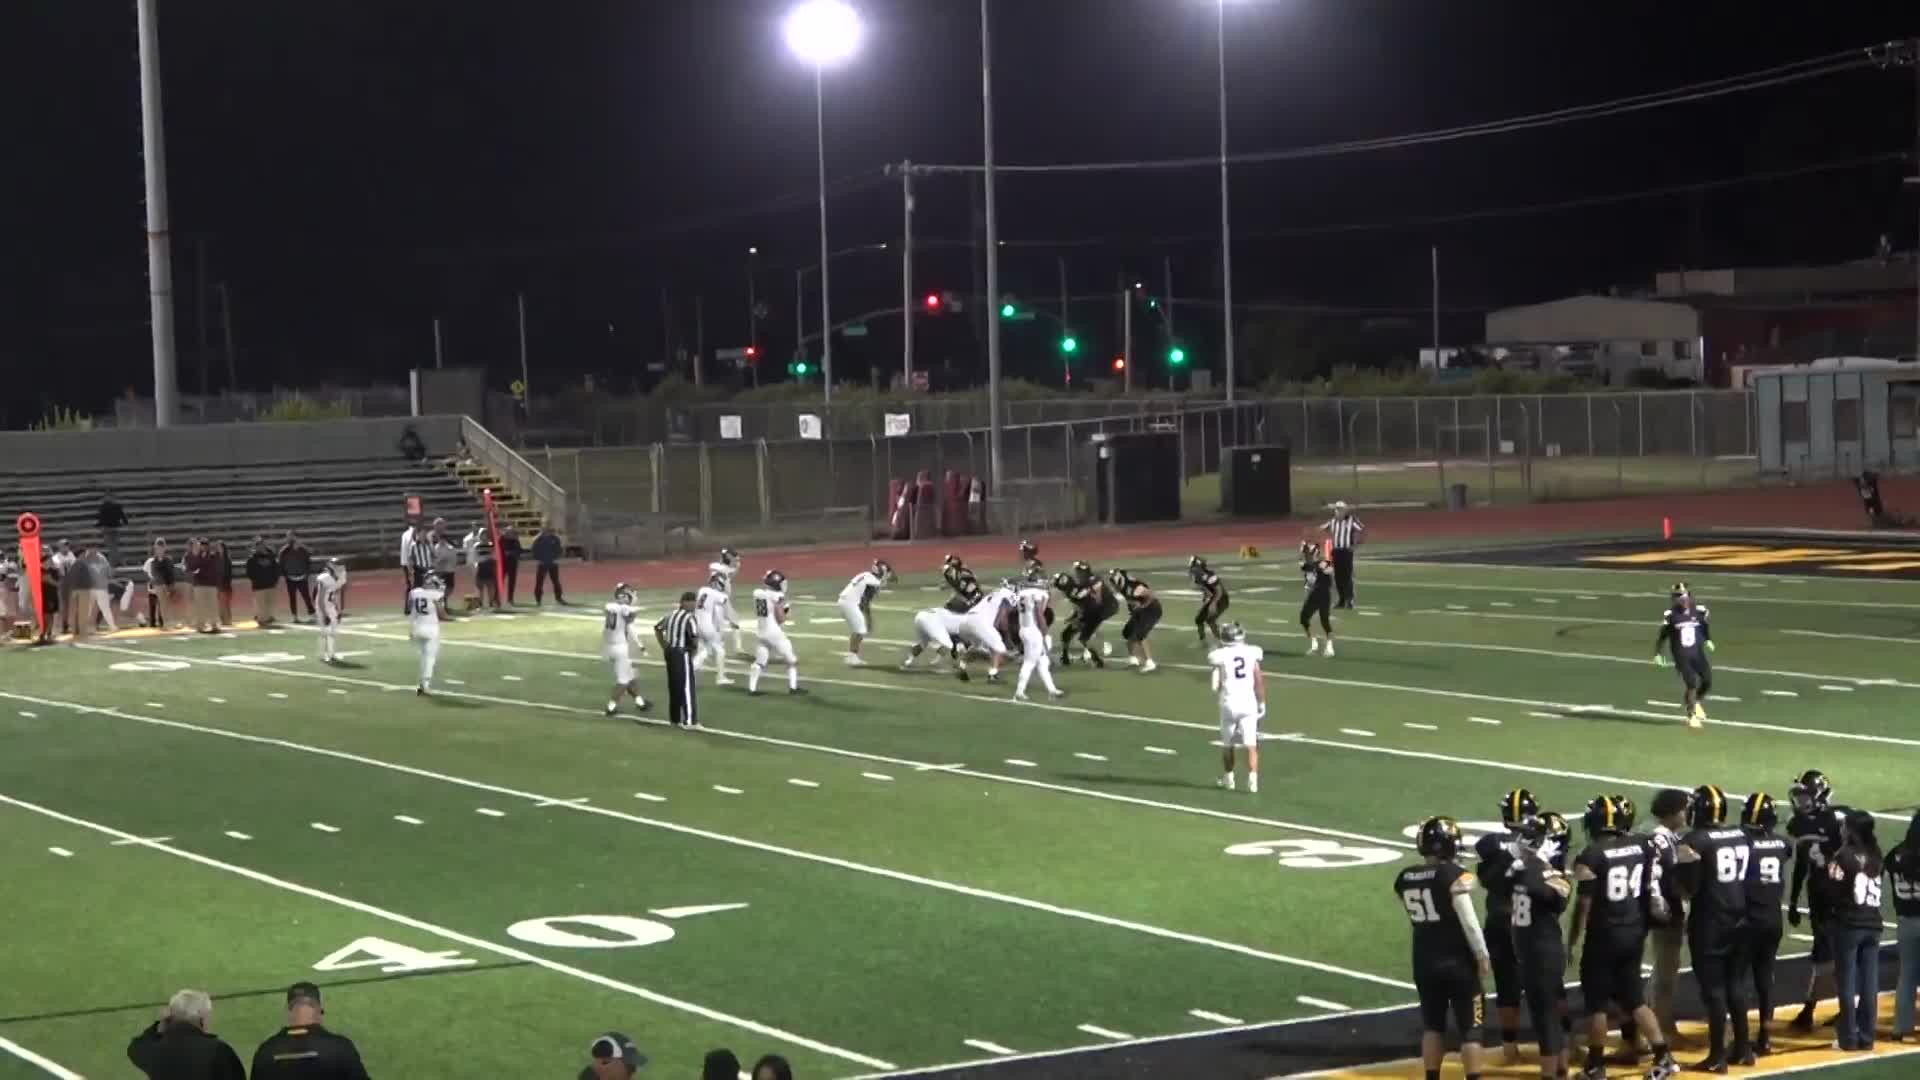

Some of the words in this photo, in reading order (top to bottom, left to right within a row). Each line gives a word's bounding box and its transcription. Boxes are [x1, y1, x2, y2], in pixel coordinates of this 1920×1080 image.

[1233, 656, 1246, 679] 2
[1224, 839, 1404, 868] 3
[1760, 856, 1780, 884] 9
[1403, 888, 1441, 922] 51
[312, 936, 478, 973] 4
[506, 914, 676, 949] 0
